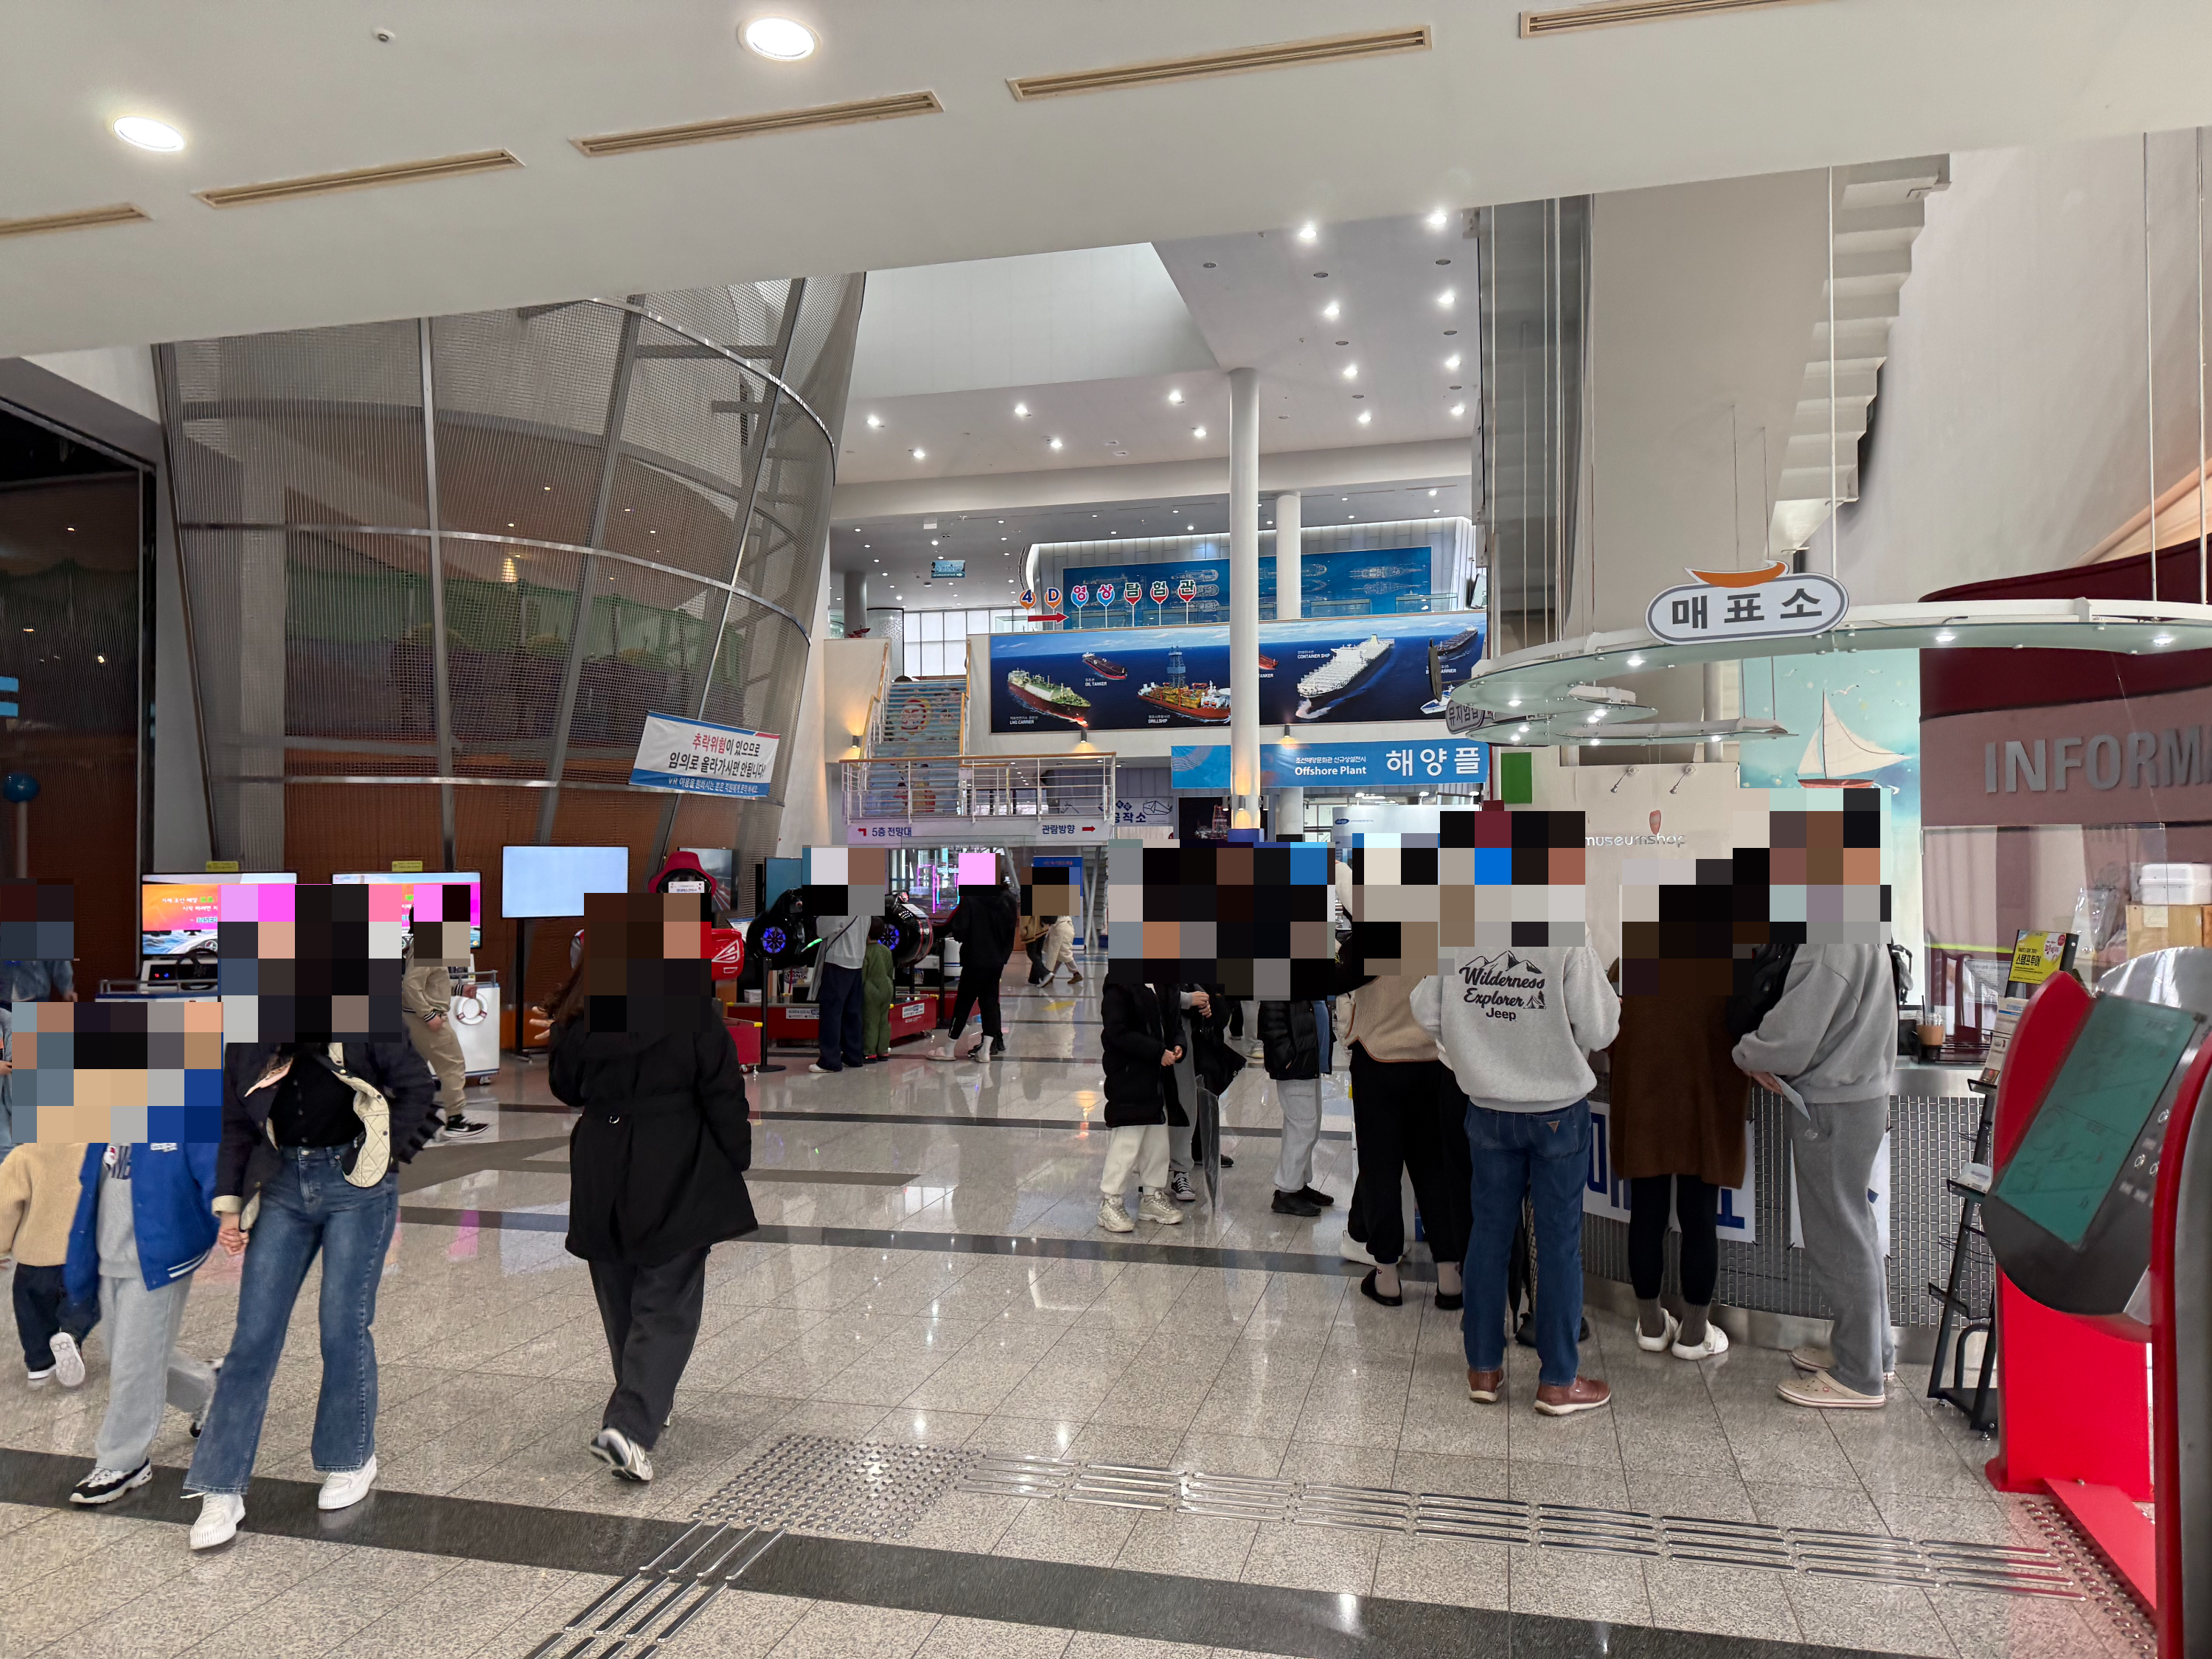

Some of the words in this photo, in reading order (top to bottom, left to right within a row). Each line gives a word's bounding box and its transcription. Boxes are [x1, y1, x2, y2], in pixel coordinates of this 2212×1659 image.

[1073, 580, 1194, 601] 영상탐험관
[1672, 588, 1823, 630] 매표소
[692, 733, 734, 756] 추락위험이
[735, 740, 760, 757] 있으므로
[669, 751, 700, 771] 임의로
[700, 757, 740, 777] 올라가시면
[1294, 766, 1338, 776] Offshore
[1340, 765, 1367, 775] Plant
[1385, 747, 1481, 776] 해양플
[872, 827, 886, 837] 5층
[887, 827, 912, 837] 전망대
[1042, 824, 1075, 835] 관람방향
[1458, 967, 1545, 989] Wilderness
[1463, 987, 1525, 1009] Explorer
[1486, 1007, 1517, 1021] Jeep
